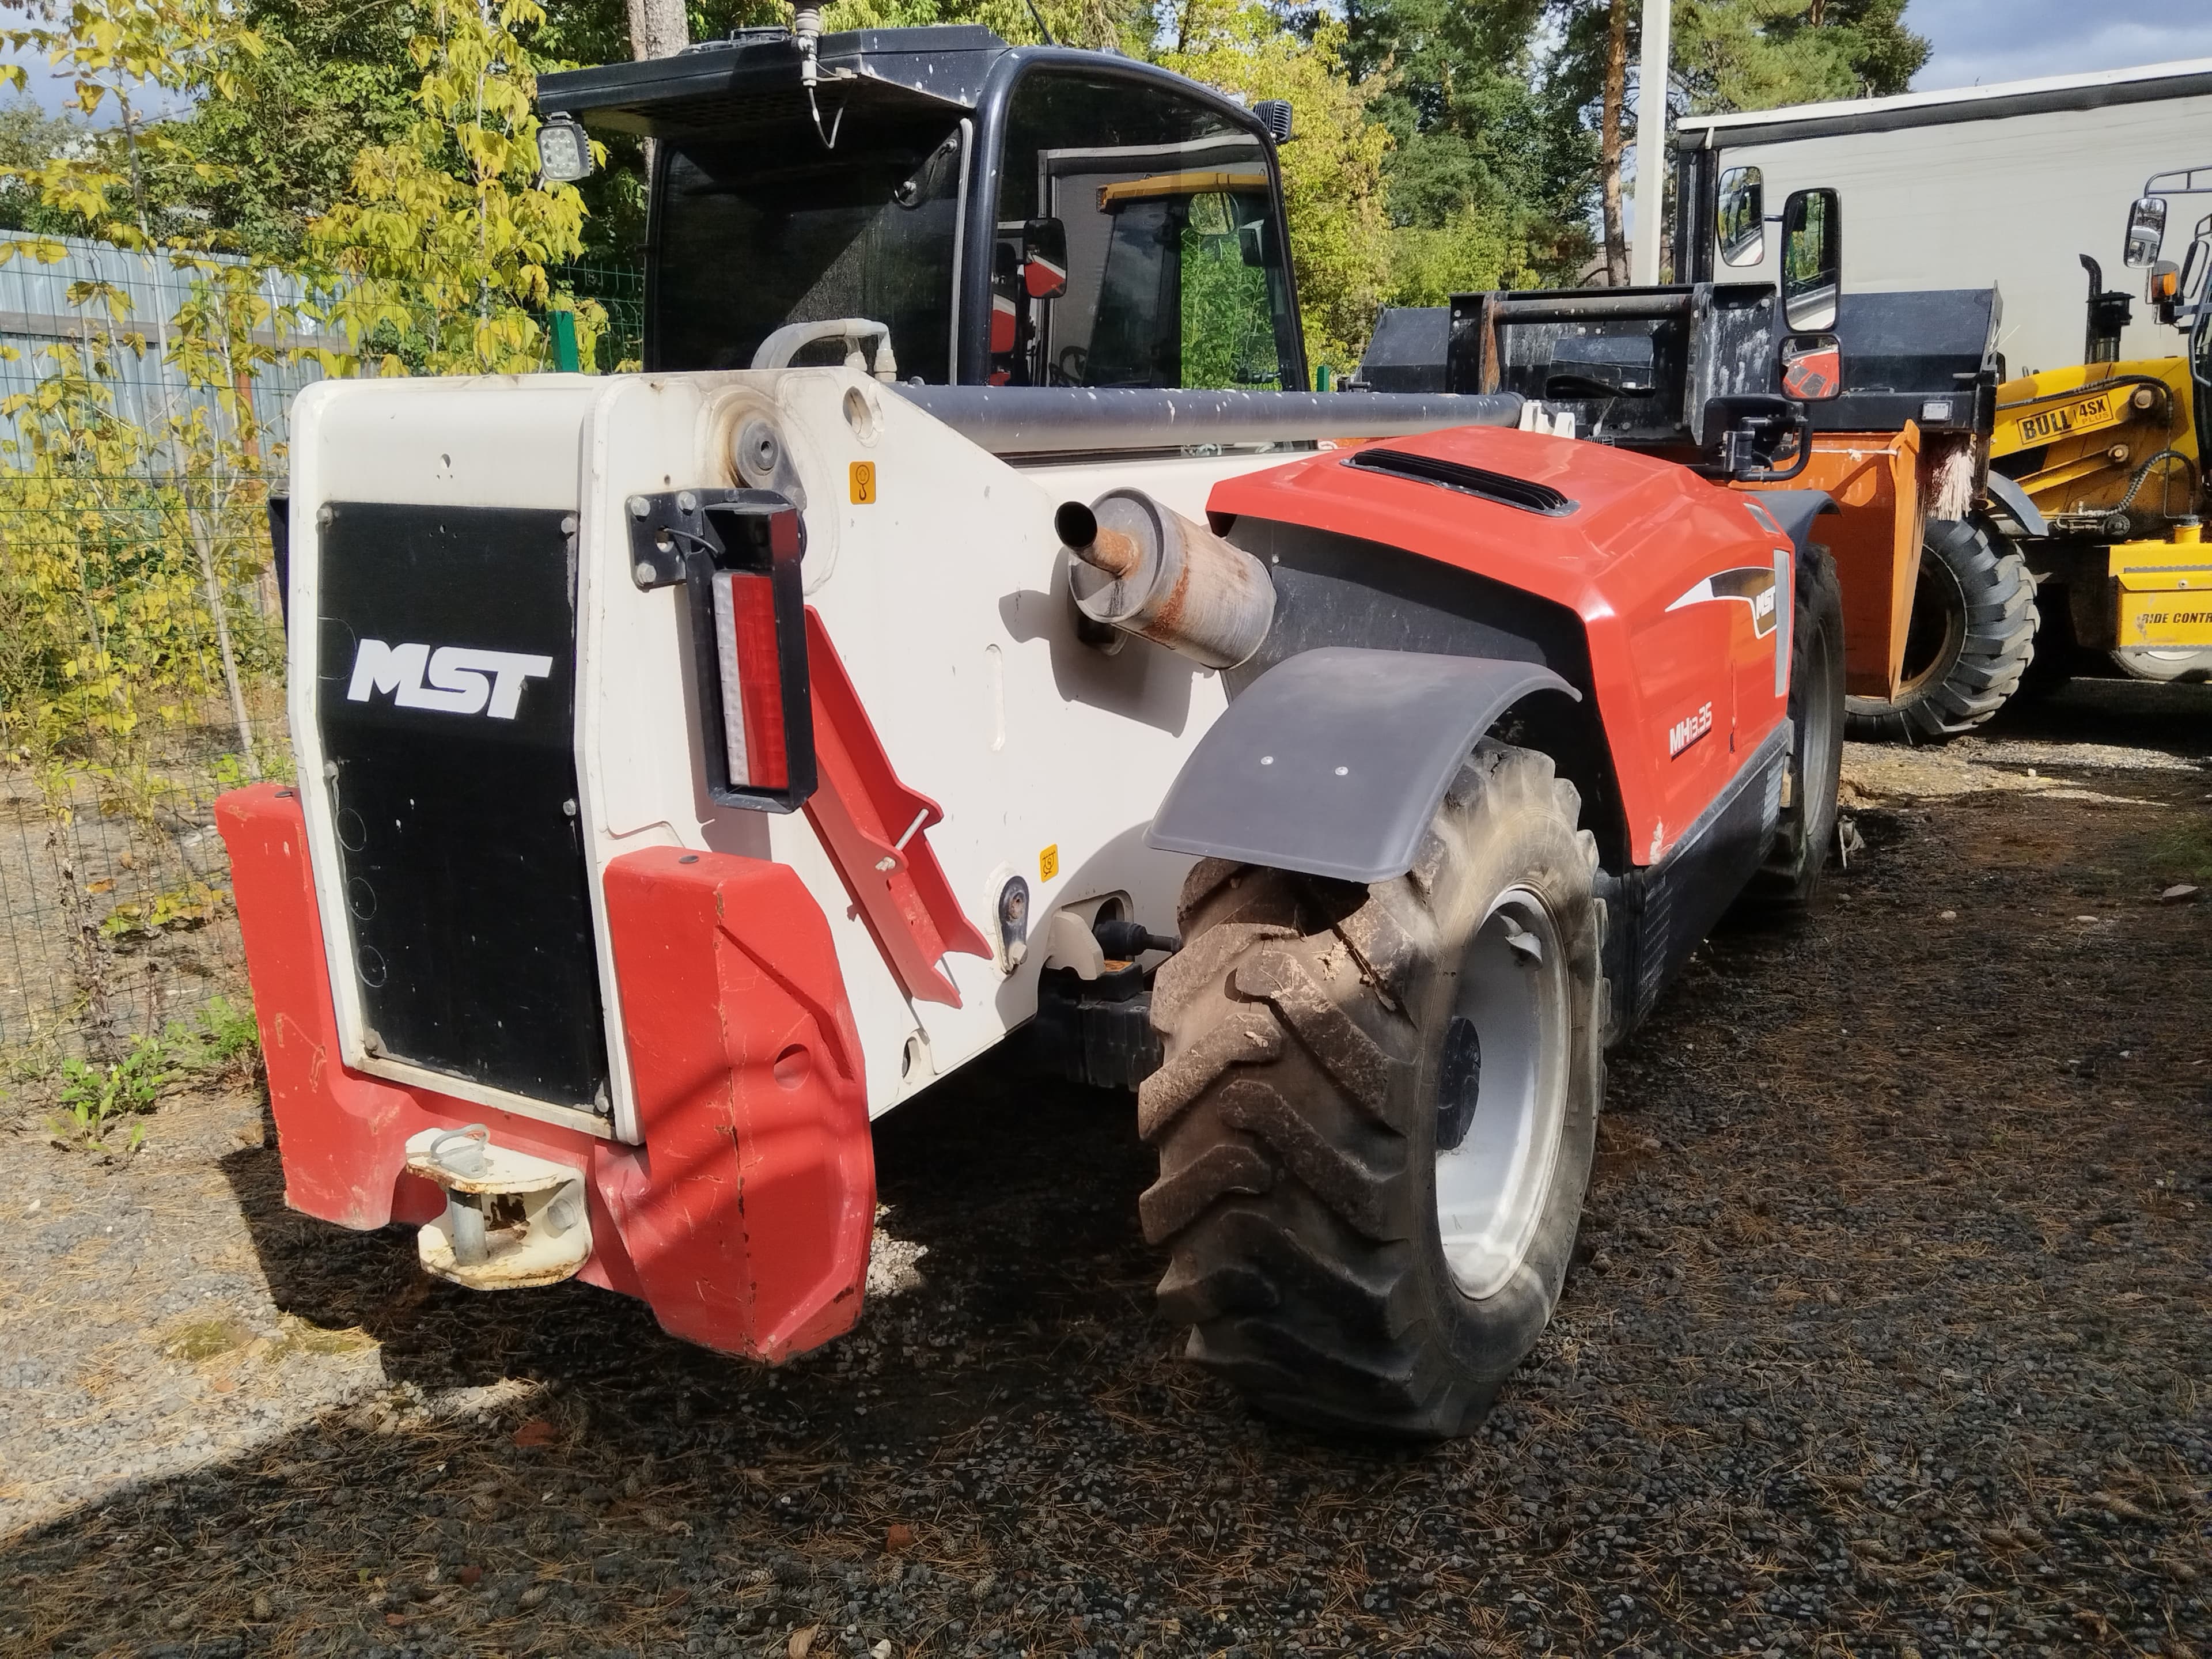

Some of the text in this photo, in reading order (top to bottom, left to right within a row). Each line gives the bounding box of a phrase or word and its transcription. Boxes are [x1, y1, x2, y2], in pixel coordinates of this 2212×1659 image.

[2022, 399, 2107, 440] BULL 4SX
[2081, 411, 2109, 425] PLUS
[1756, 585, 1776, 620] MST
[2142, 613, 2169, 623] RIDE
[347, 638, 554, 720] MST
